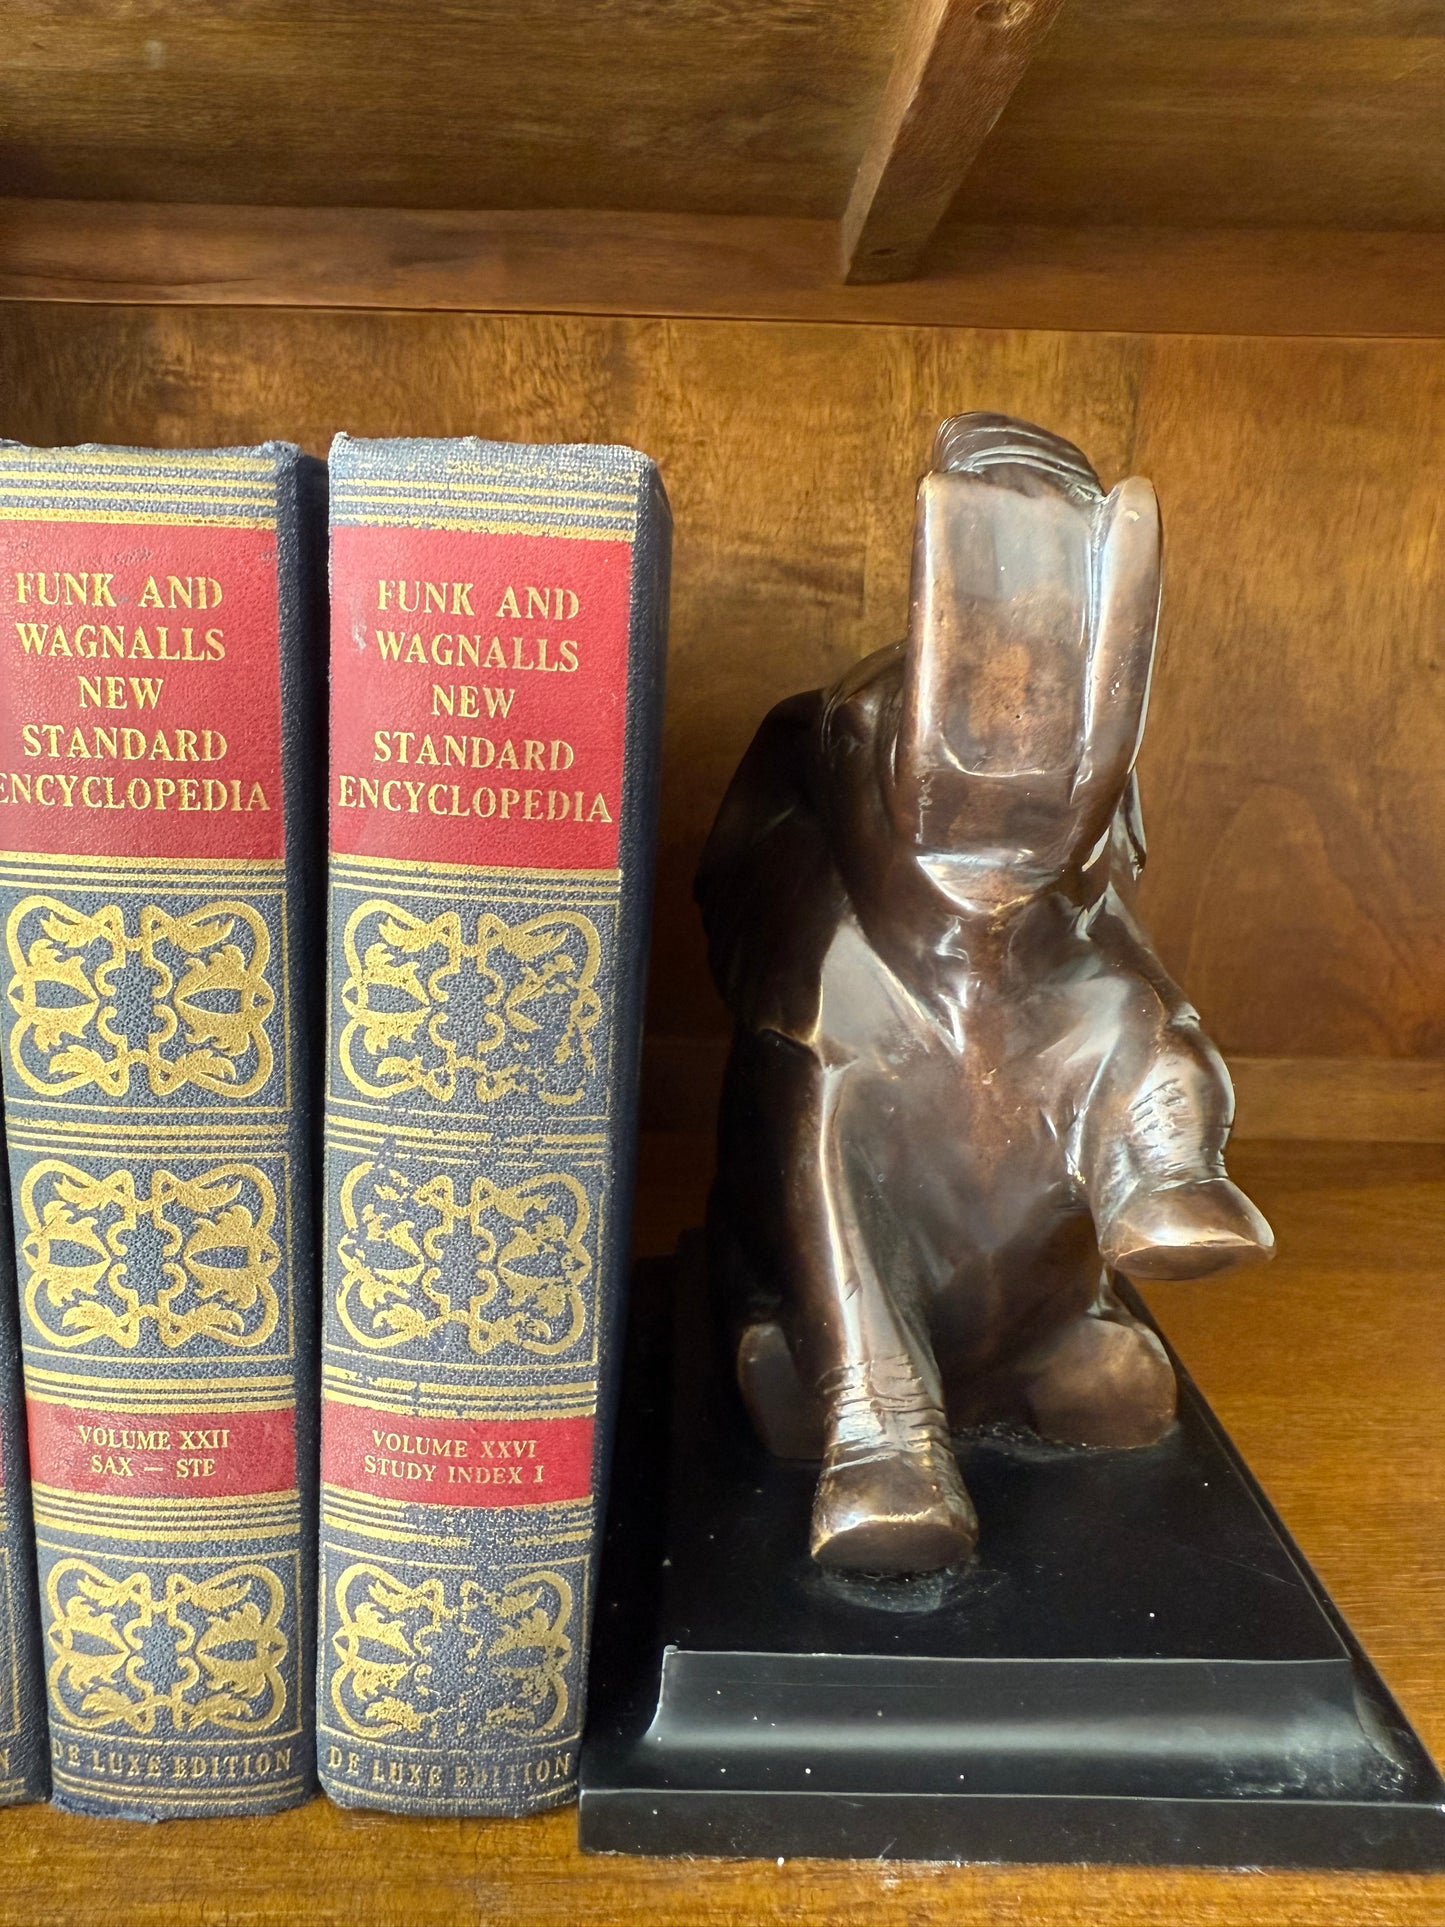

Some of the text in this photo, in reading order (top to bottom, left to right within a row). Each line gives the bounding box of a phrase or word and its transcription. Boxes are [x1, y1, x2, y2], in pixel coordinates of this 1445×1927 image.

[16, 571, 223, 609] FUNK AND
[377, 579, 581, 620] FUNK AND
[15, 623, 226, 661] WAGNALLS
[376, 630, 580, 672] WAGNALLS
[78, 676, 164, 710] NEW
[432, 685, 515, 718] NEW
[23, 725, 228, 761] STANDARD
[374, 731, 573, 771] STANDARD
[0, 773, 271, 812] ENCYCLOPEDIA
[338, 776, 612, 822] ENCYCLOPEDIA
[77, 1425, 229, 1451] VOLUME XXII
[371, 1430, 537, 1459] VOLUME XXVI
[91, 1454, 133, 1477] SAX
[176, 1456, 215, 1478] STE
[365, 1455, 544, 1485] STUDY INDEX I
[53, 1744, 293, 1778] DE LUXE EDITION
[329, 1746, 572, 1788] DE LUXE EDITION
